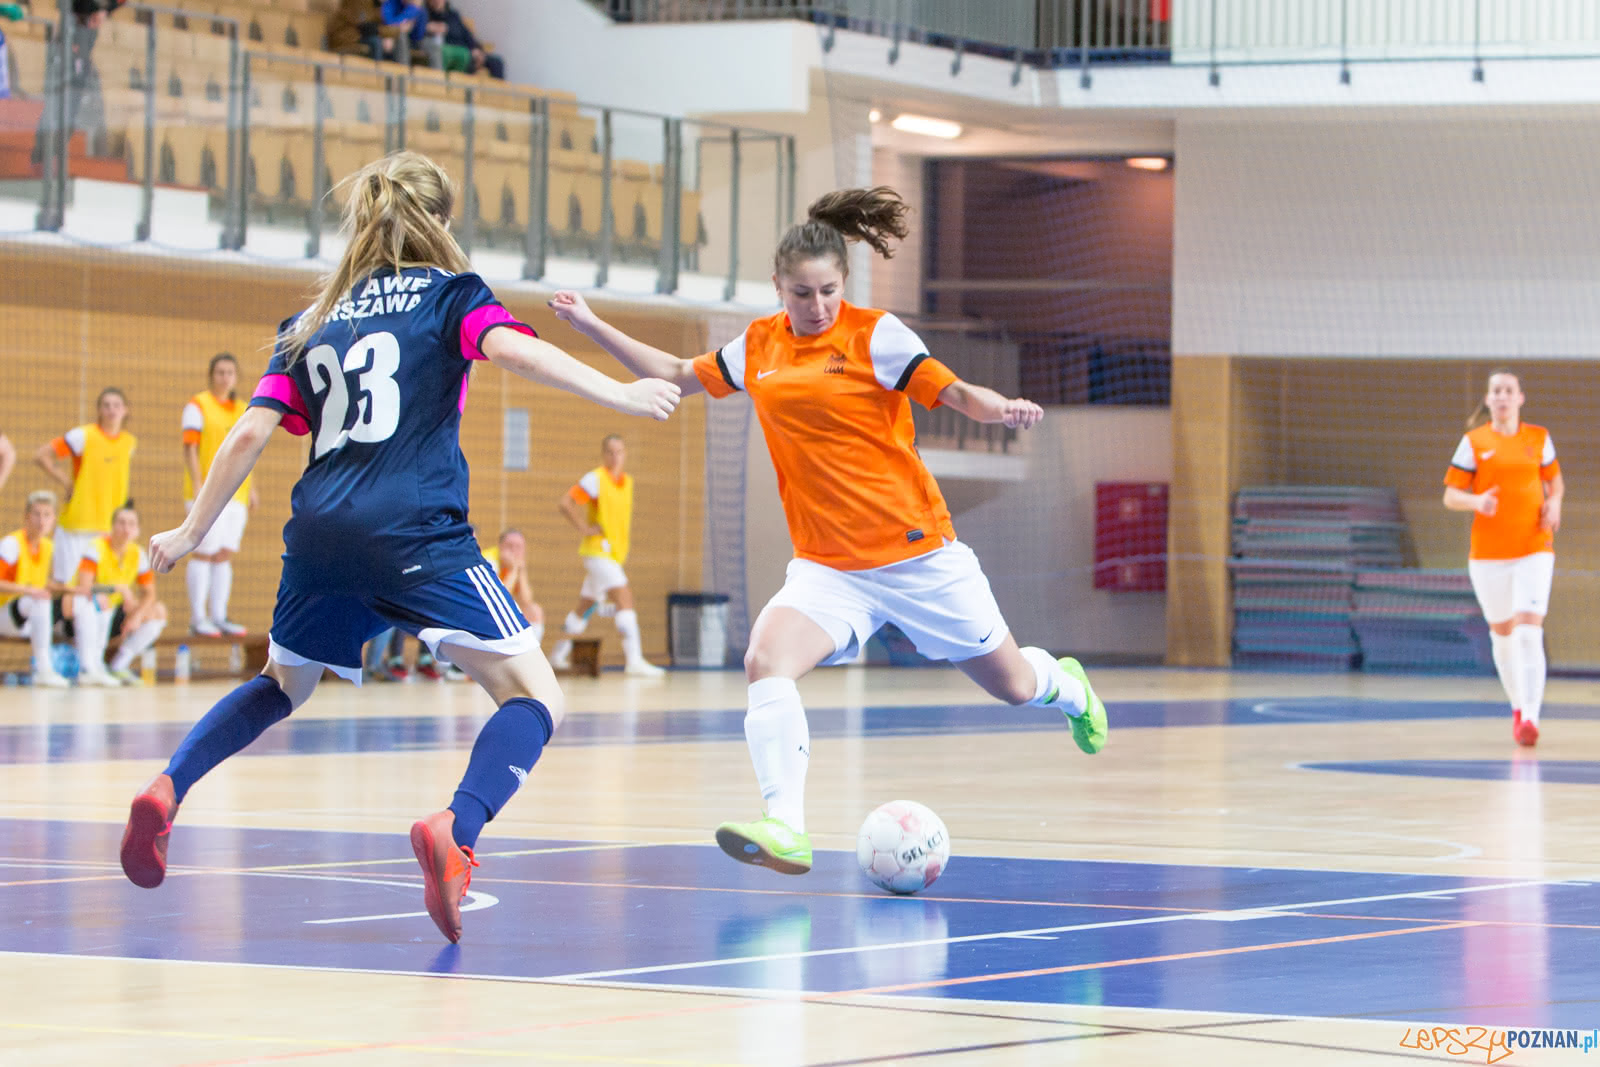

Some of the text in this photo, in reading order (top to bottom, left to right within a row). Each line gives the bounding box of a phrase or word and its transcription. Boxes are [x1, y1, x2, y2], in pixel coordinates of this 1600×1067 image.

[360, 276, 432, 298] AWF
[313, 293, 422, 324] RSZAWA
[306, 331, 400, 460] 23
